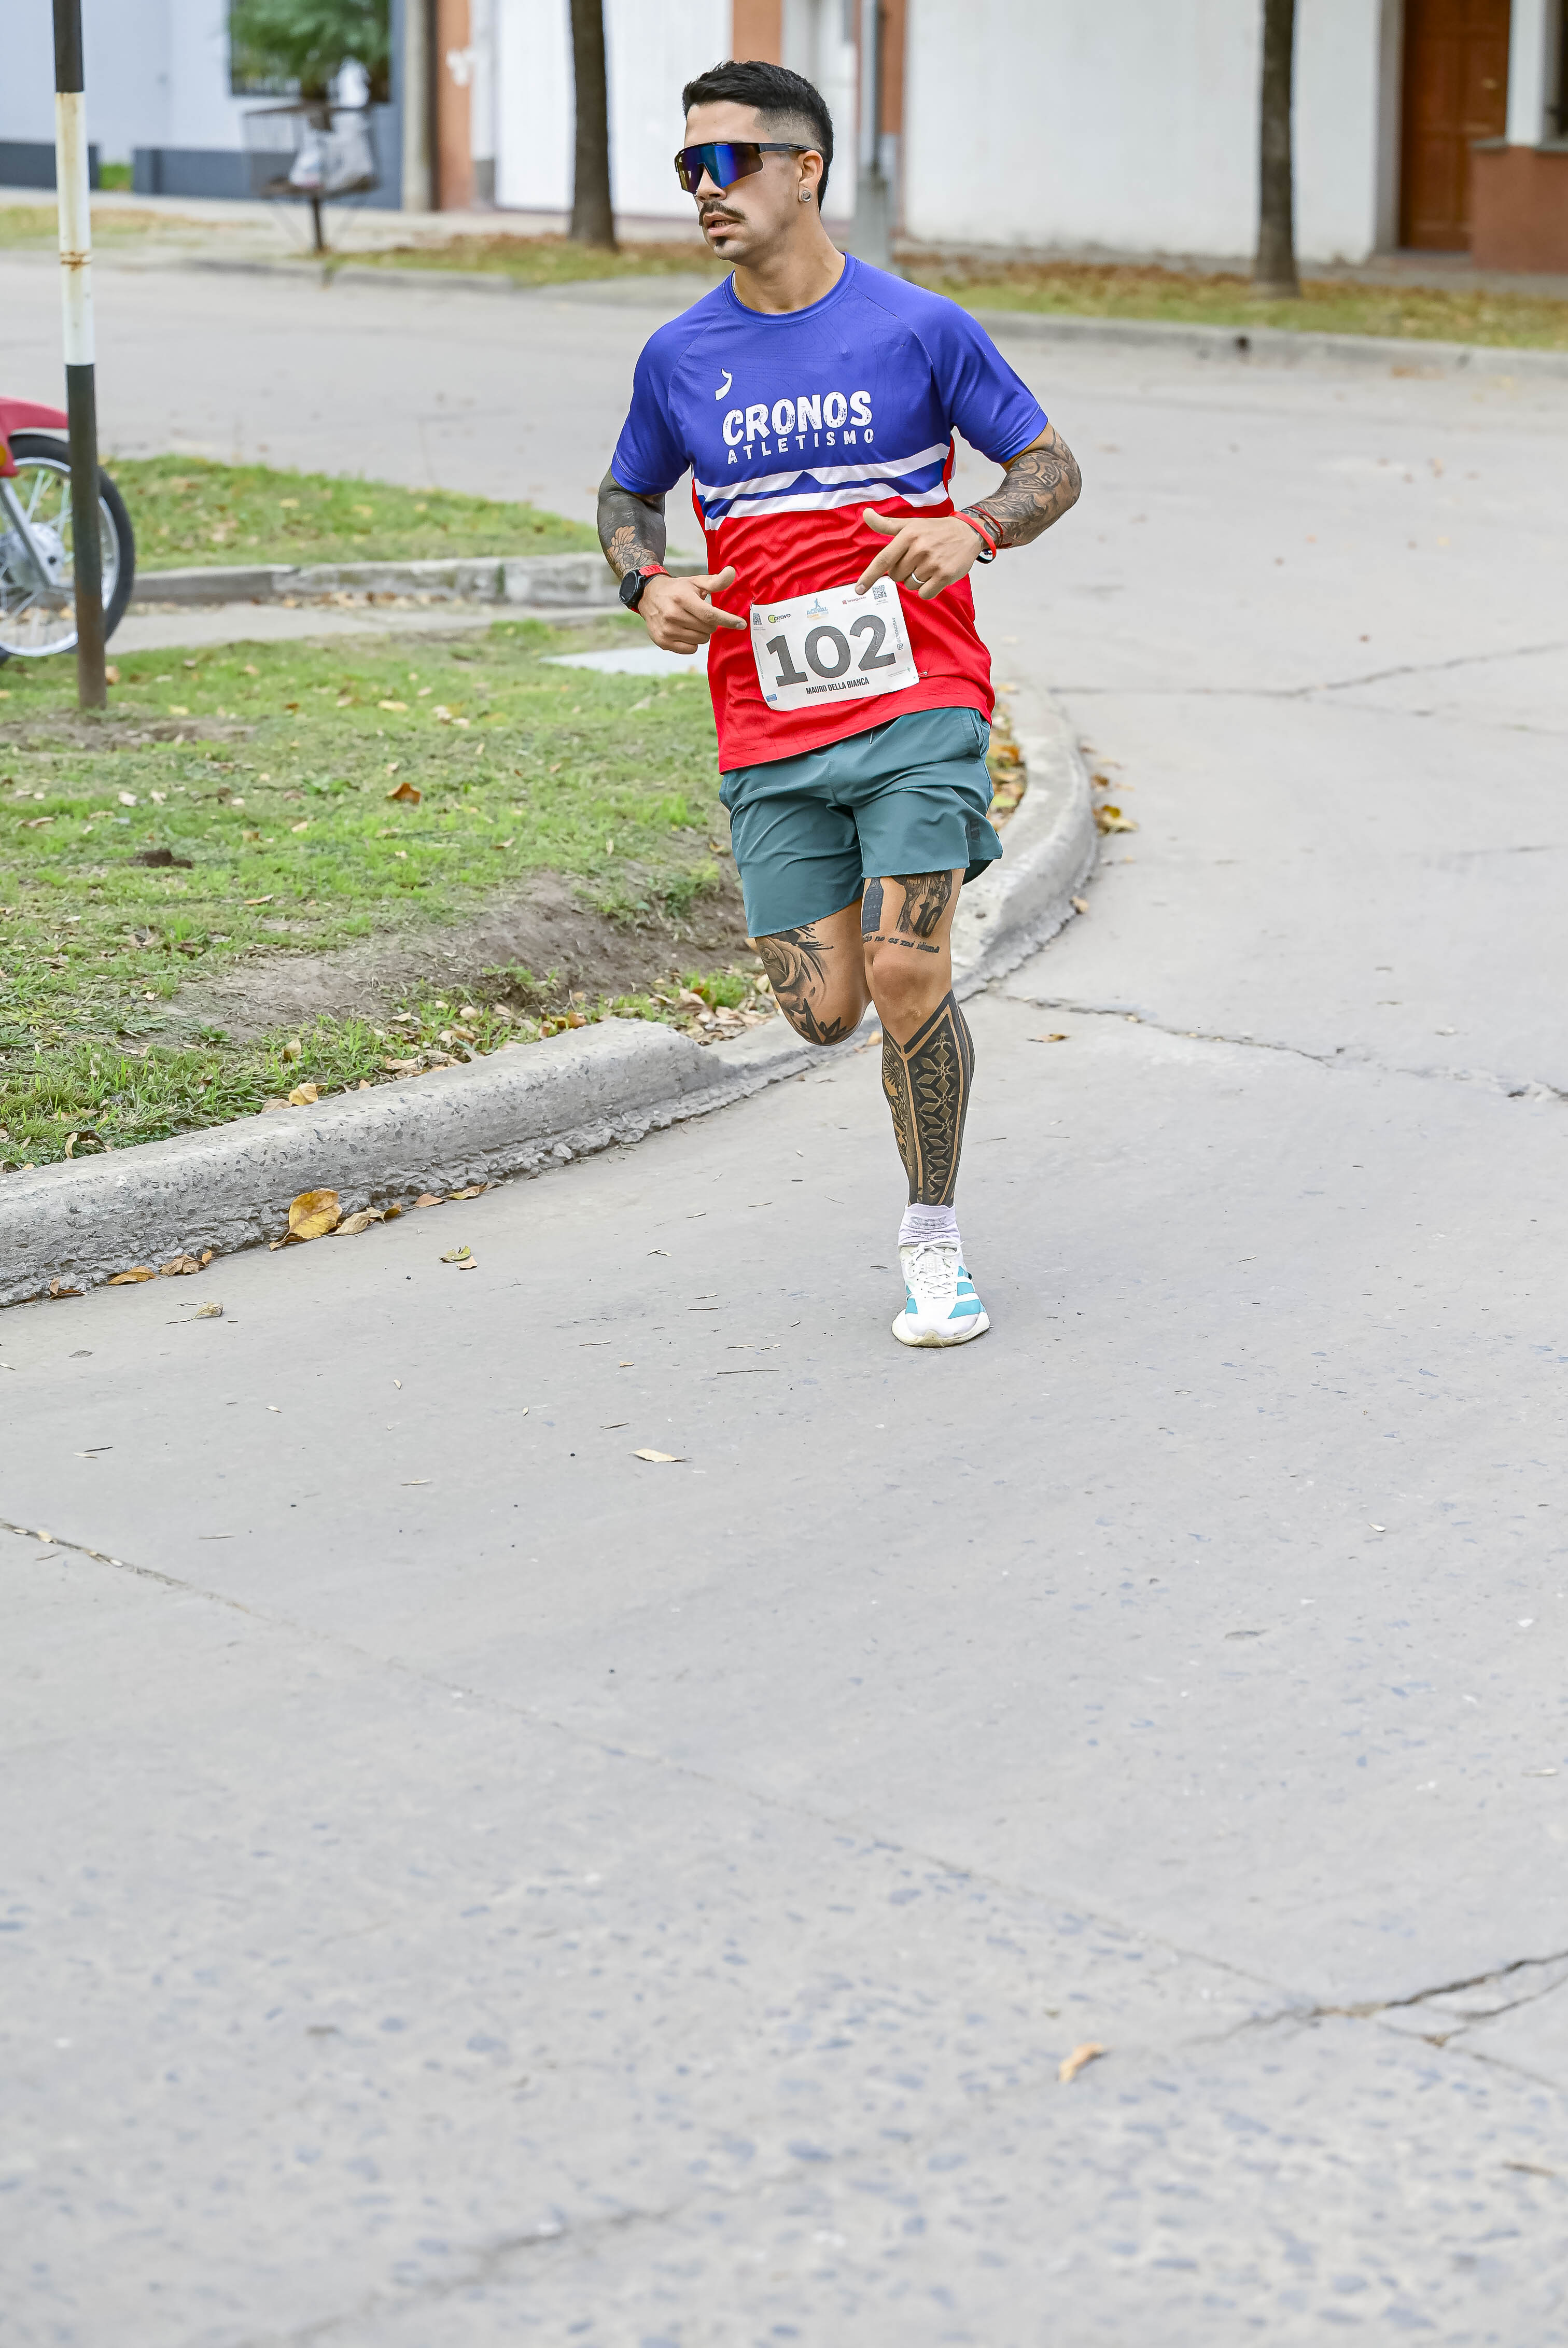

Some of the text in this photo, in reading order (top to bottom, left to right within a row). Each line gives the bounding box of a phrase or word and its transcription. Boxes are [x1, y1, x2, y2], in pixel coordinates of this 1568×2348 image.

[722, 390, 872, 446] CRONOS
[727, 428, 875, 465] ATLETISMO
[766, 614, 897, 687] 102
[805, 677, 870, 695] MAURO DELLA BIANCA
[912, 901, 943, 938] 10
